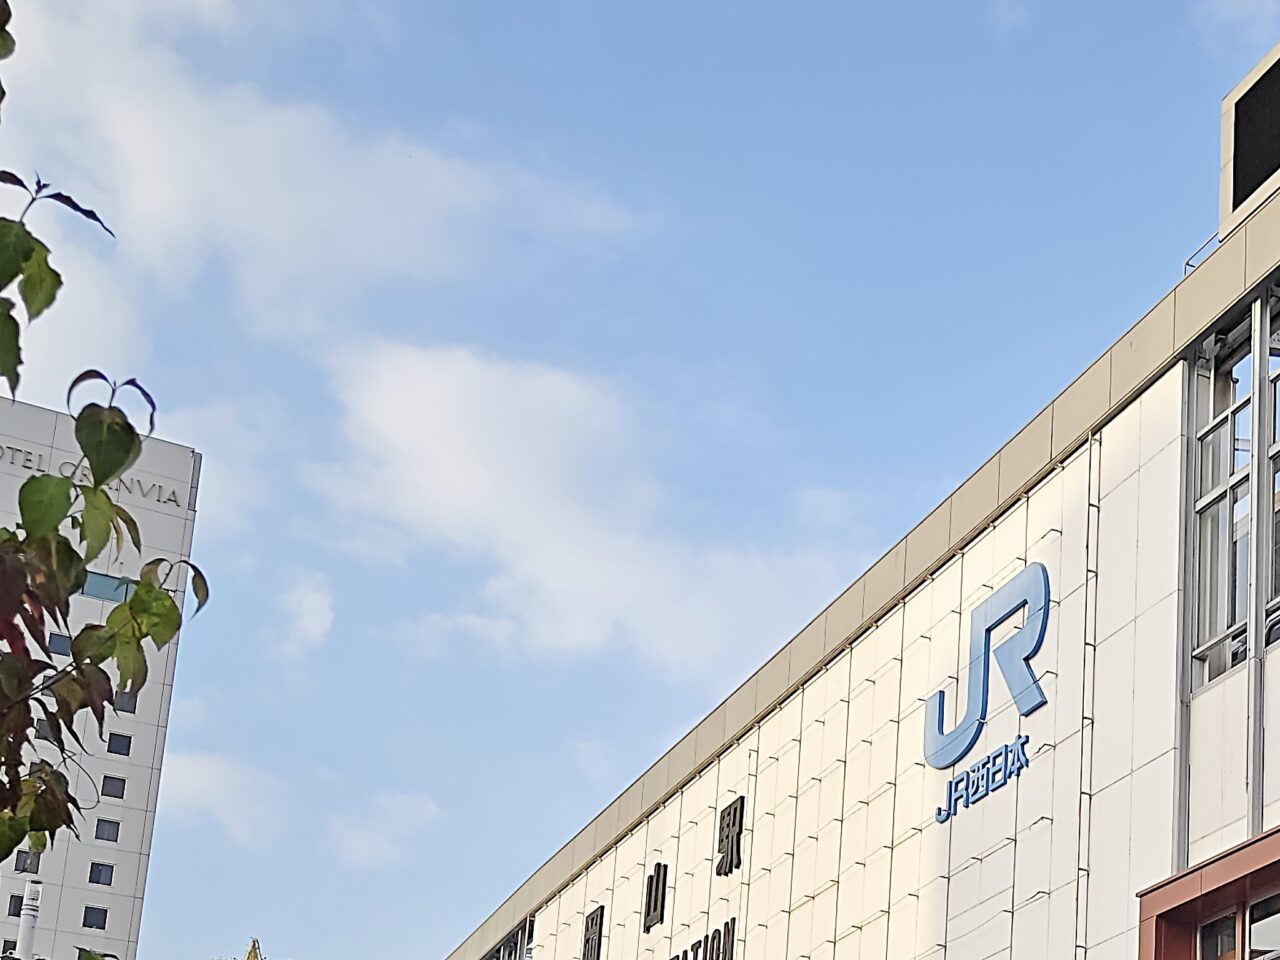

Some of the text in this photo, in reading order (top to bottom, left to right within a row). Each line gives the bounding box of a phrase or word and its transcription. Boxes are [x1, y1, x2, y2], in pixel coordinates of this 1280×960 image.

[59, 462, 181, 507] GRNVIA
[923, 562, 1051, 770] JR
[935, 735, 1030, 824] JR西日本
